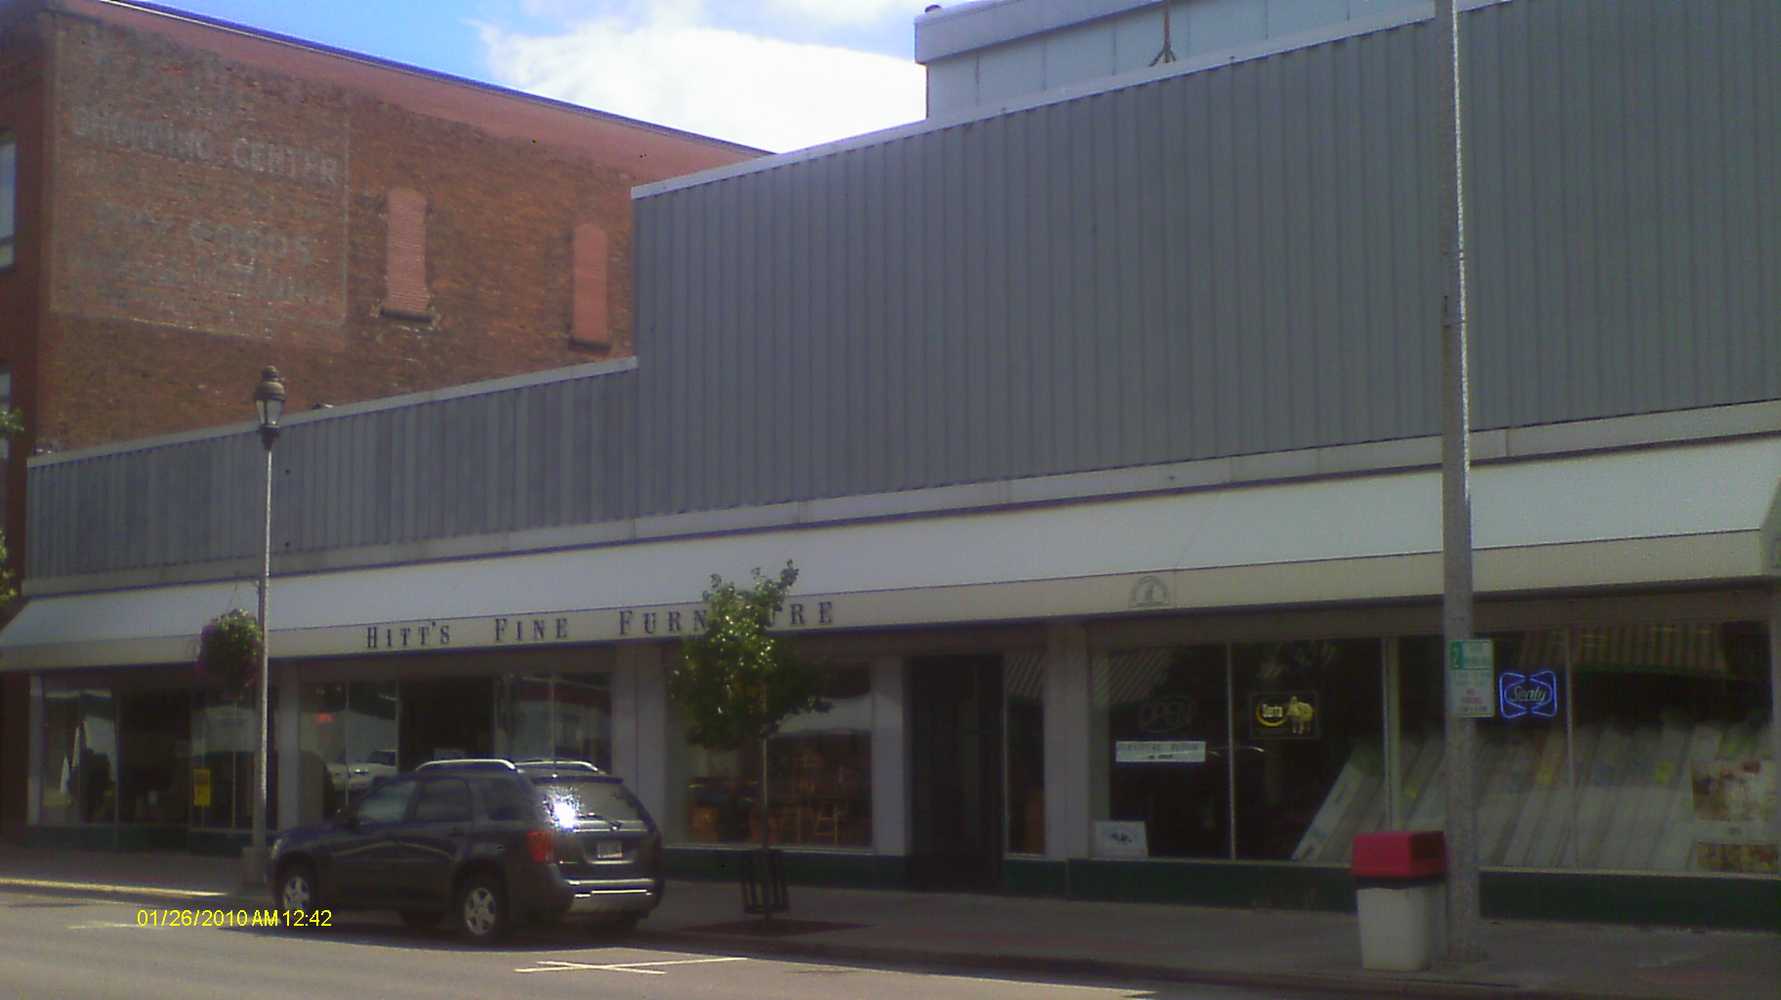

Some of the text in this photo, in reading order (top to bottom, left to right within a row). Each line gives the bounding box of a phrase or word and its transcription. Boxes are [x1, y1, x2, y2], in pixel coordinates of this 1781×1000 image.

[367, 601, 834, 648] HITT'S FINE FURNRE
